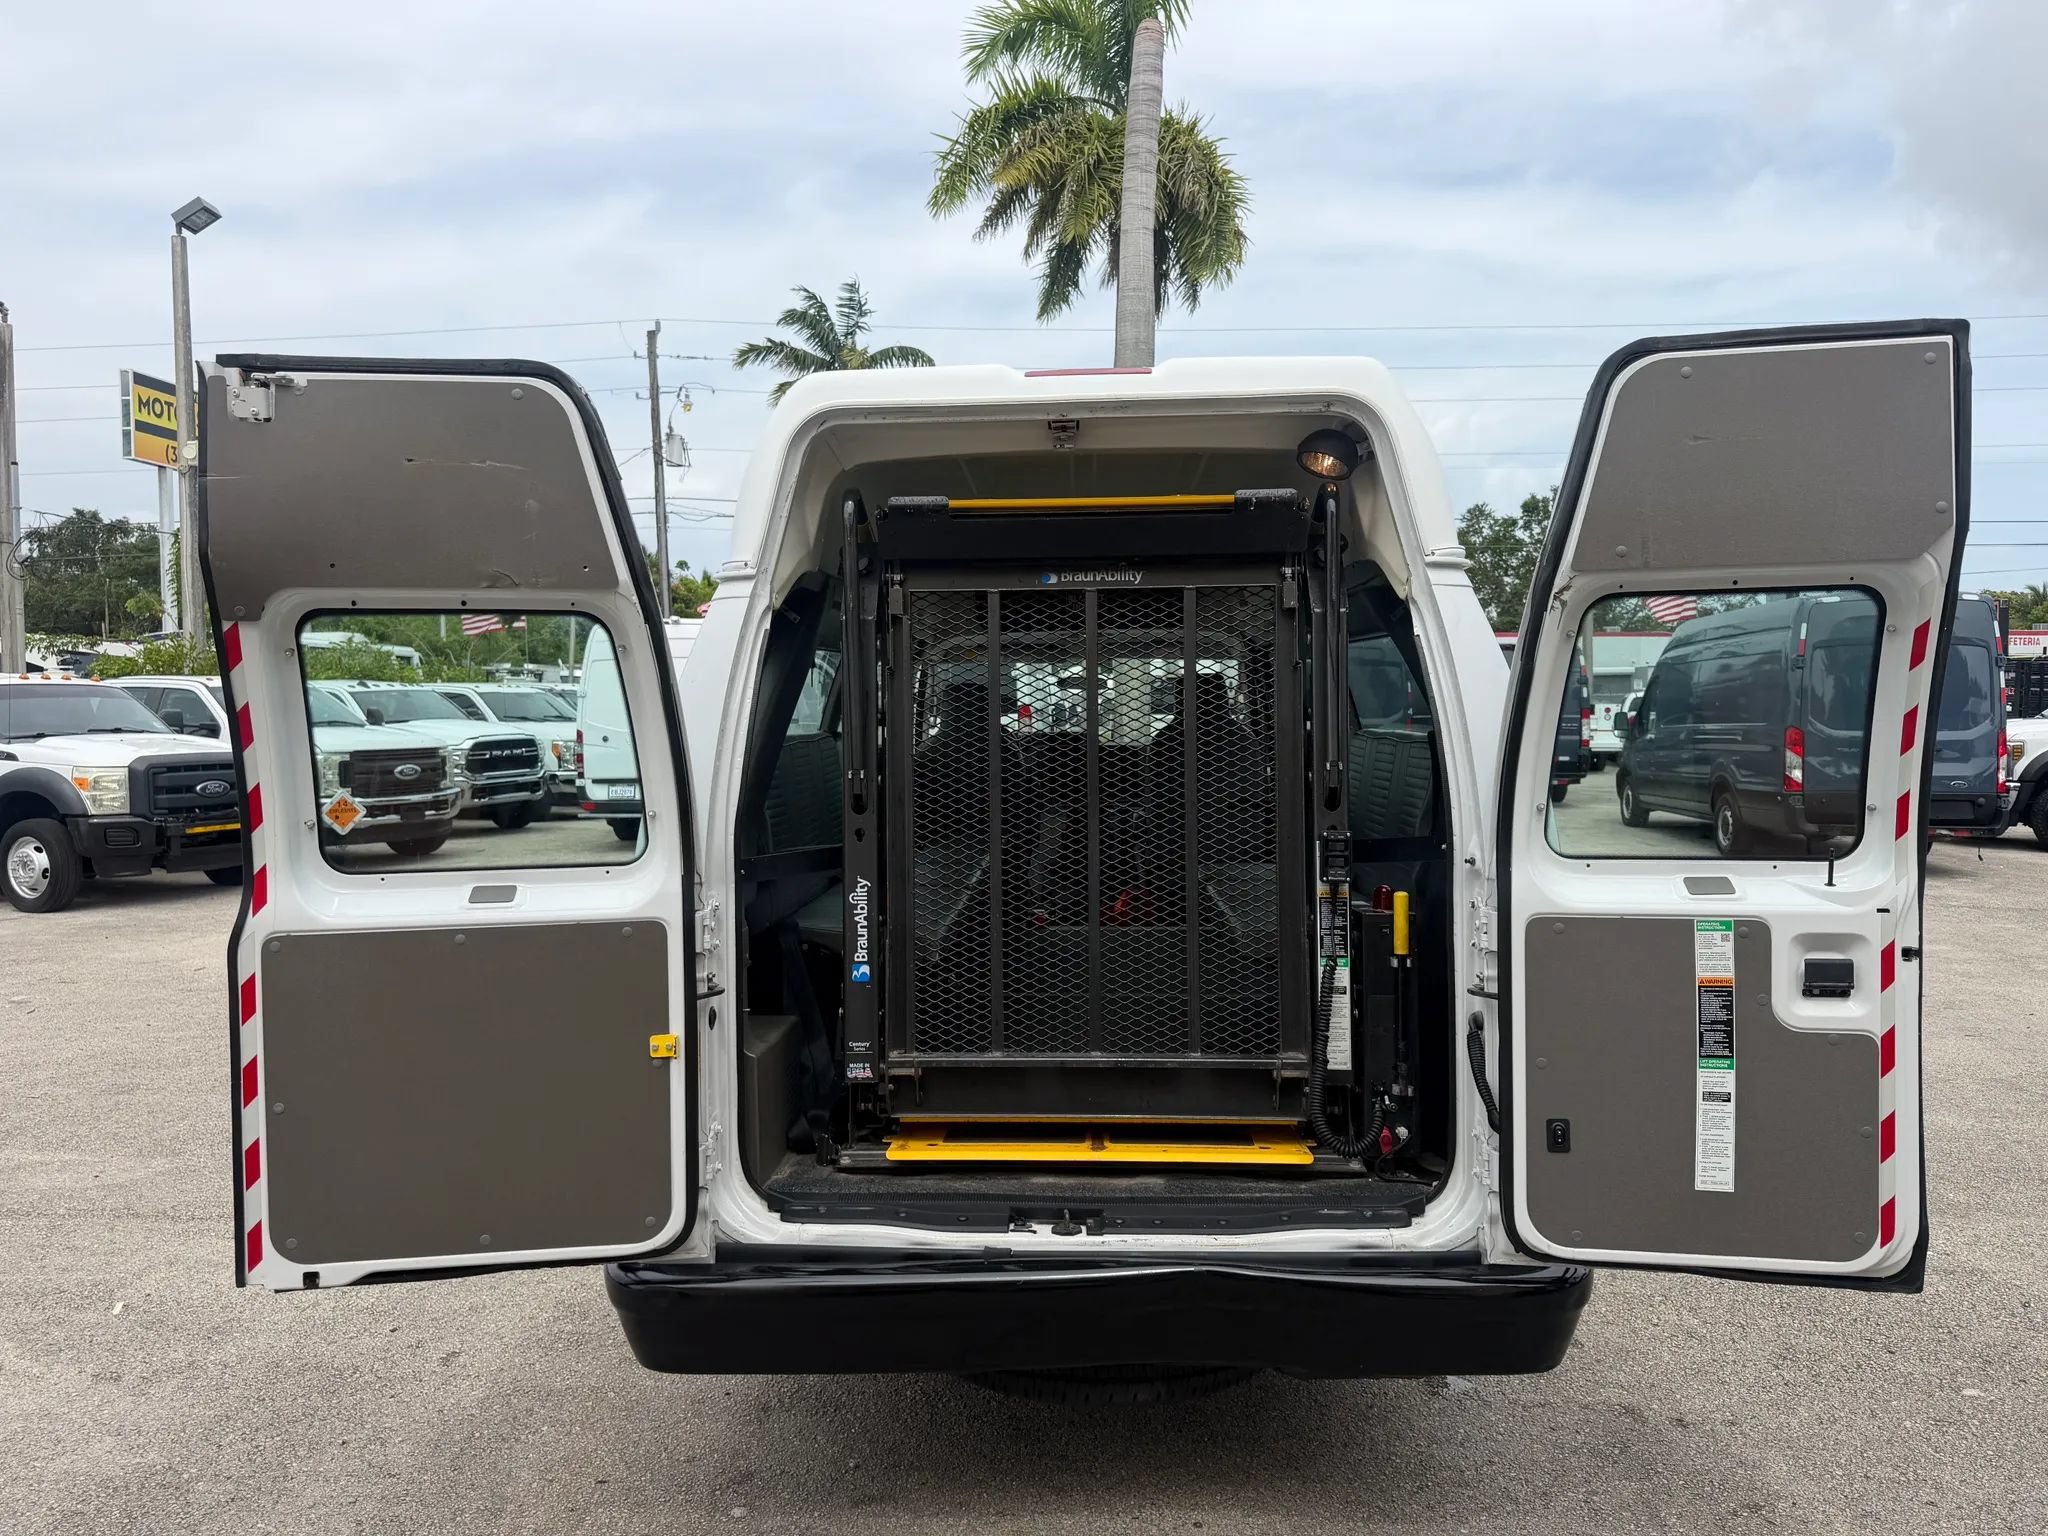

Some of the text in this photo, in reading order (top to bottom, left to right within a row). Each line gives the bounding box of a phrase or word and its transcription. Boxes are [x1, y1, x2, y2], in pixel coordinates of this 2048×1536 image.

[138, 391, 177, 422] MOT
[1061, 565, 1142, 584] BraunAbility
[492, 749, 523, 758] RAM
[849, 876, 871, 962] BraunAbility
[847, 1067, 873, 1078] USA
